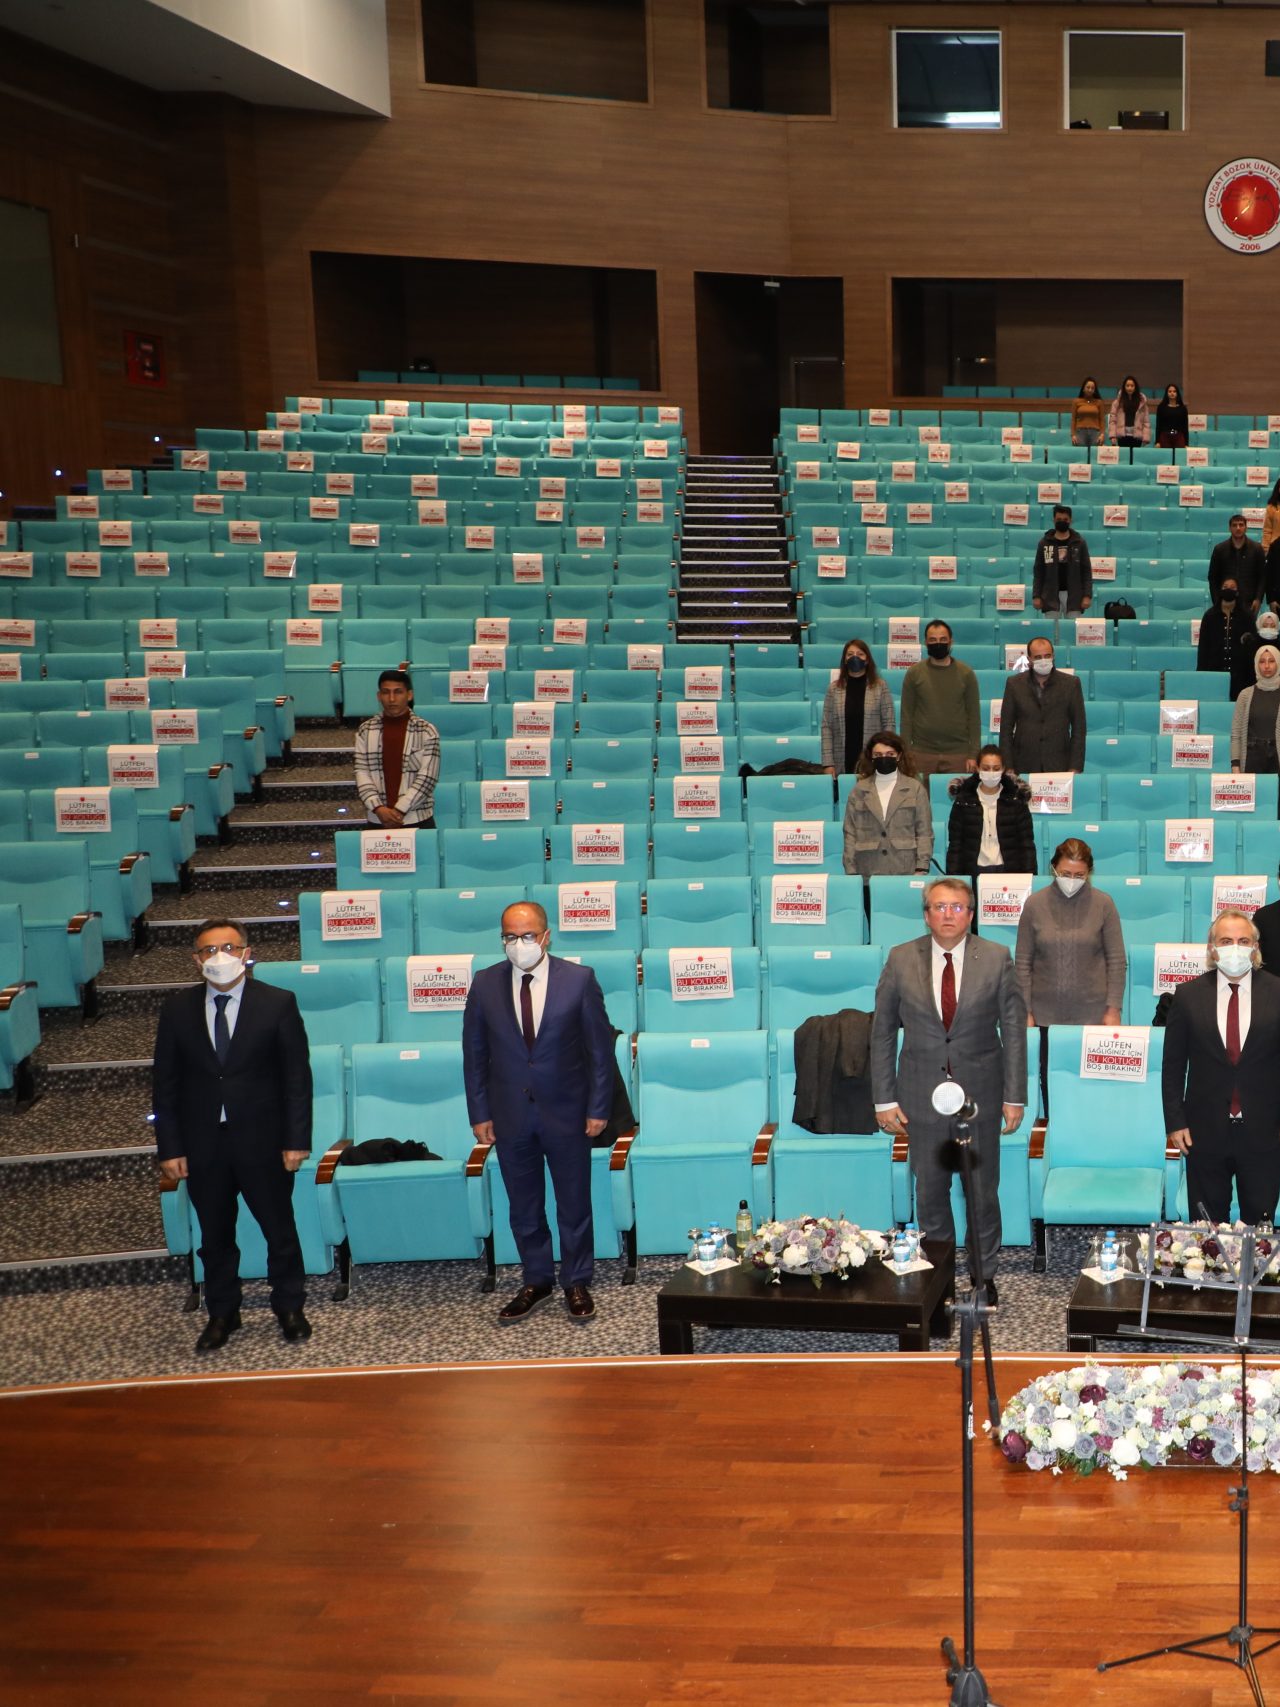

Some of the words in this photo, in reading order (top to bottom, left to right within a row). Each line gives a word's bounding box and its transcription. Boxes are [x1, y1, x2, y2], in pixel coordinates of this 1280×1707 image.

[1208, 176, 1225, 209] YOZGAT
[1223, 162, 1252, 178] BOZOK
[1239, 242, 1261, 251] 2006
[336, 904, 365, 912] LÜTFEN
[577, 909, 610, 917] KOLTUĞU
[685, 962, 716, 971] LÜTFEN
[1169, 961, 1198, 969] LÜTFEN
[675, 970, 712, 978] SAĞLIĞINIZ
[690, 976, 727, 985] KOLTUĞU
[428, 988, 466, 996] KOLTUĞU
[1099, 1040, 1132, 1049] LÜTFEN
[1087, 1047, 1126, 1056] SAĞLIĞINIZ
[1088, 1055, 1099, 1063] BU
[1102, 1056, 1141, 1066] KOLTUĞU
[1087, 1063, 1102, 1071] BOŞ
[1105, 1065, 1141, 1073] BIRAKINIZ
